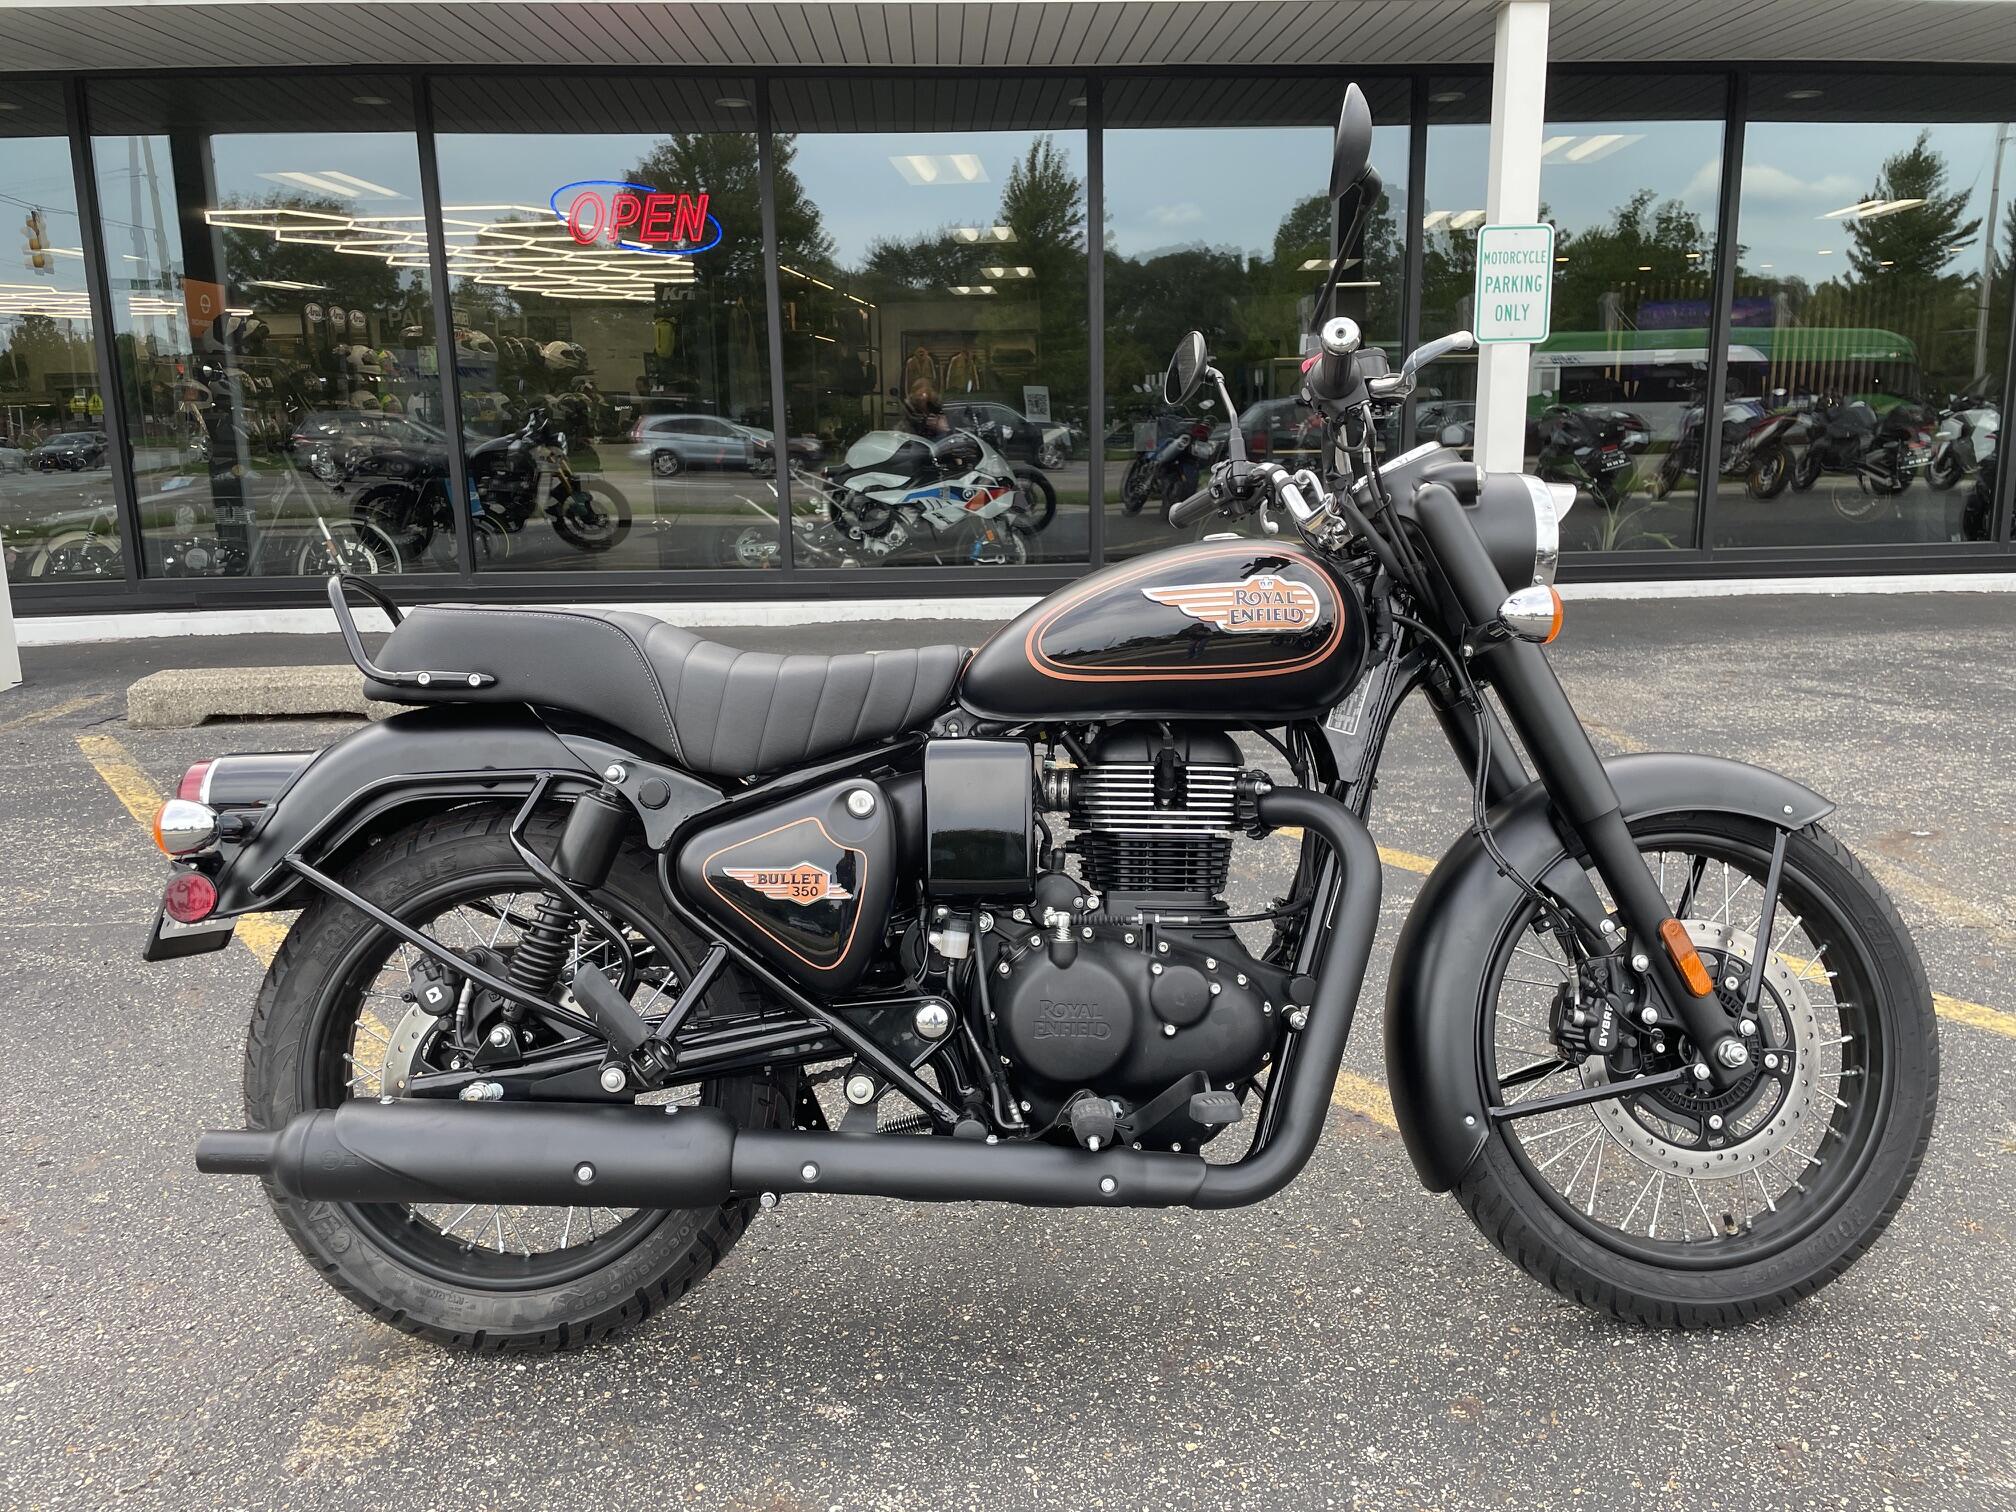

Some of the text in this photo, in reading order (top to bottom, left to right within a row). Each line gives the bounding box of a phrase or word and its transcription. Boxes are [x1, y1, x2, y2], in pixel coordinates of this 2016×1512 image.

[568, 191, 709, 245] OPEN
[1483, 250, 1547, 265] MOTORCYCLE
[1485, 275, 1542, 294] PARKING
[1495, 303, 1530, 322] ONLY
[1235, 589, 1295, 606] ROYAL
[1230, 608, 1305, 625] ENFIELD
[757, 873, 823, 885] BULLET
[792, 886, 819, 897] 350
[1040, 999, 1103, 1020] ROYAL
[1033, 1020, 1112, 1040] ENFIELD
